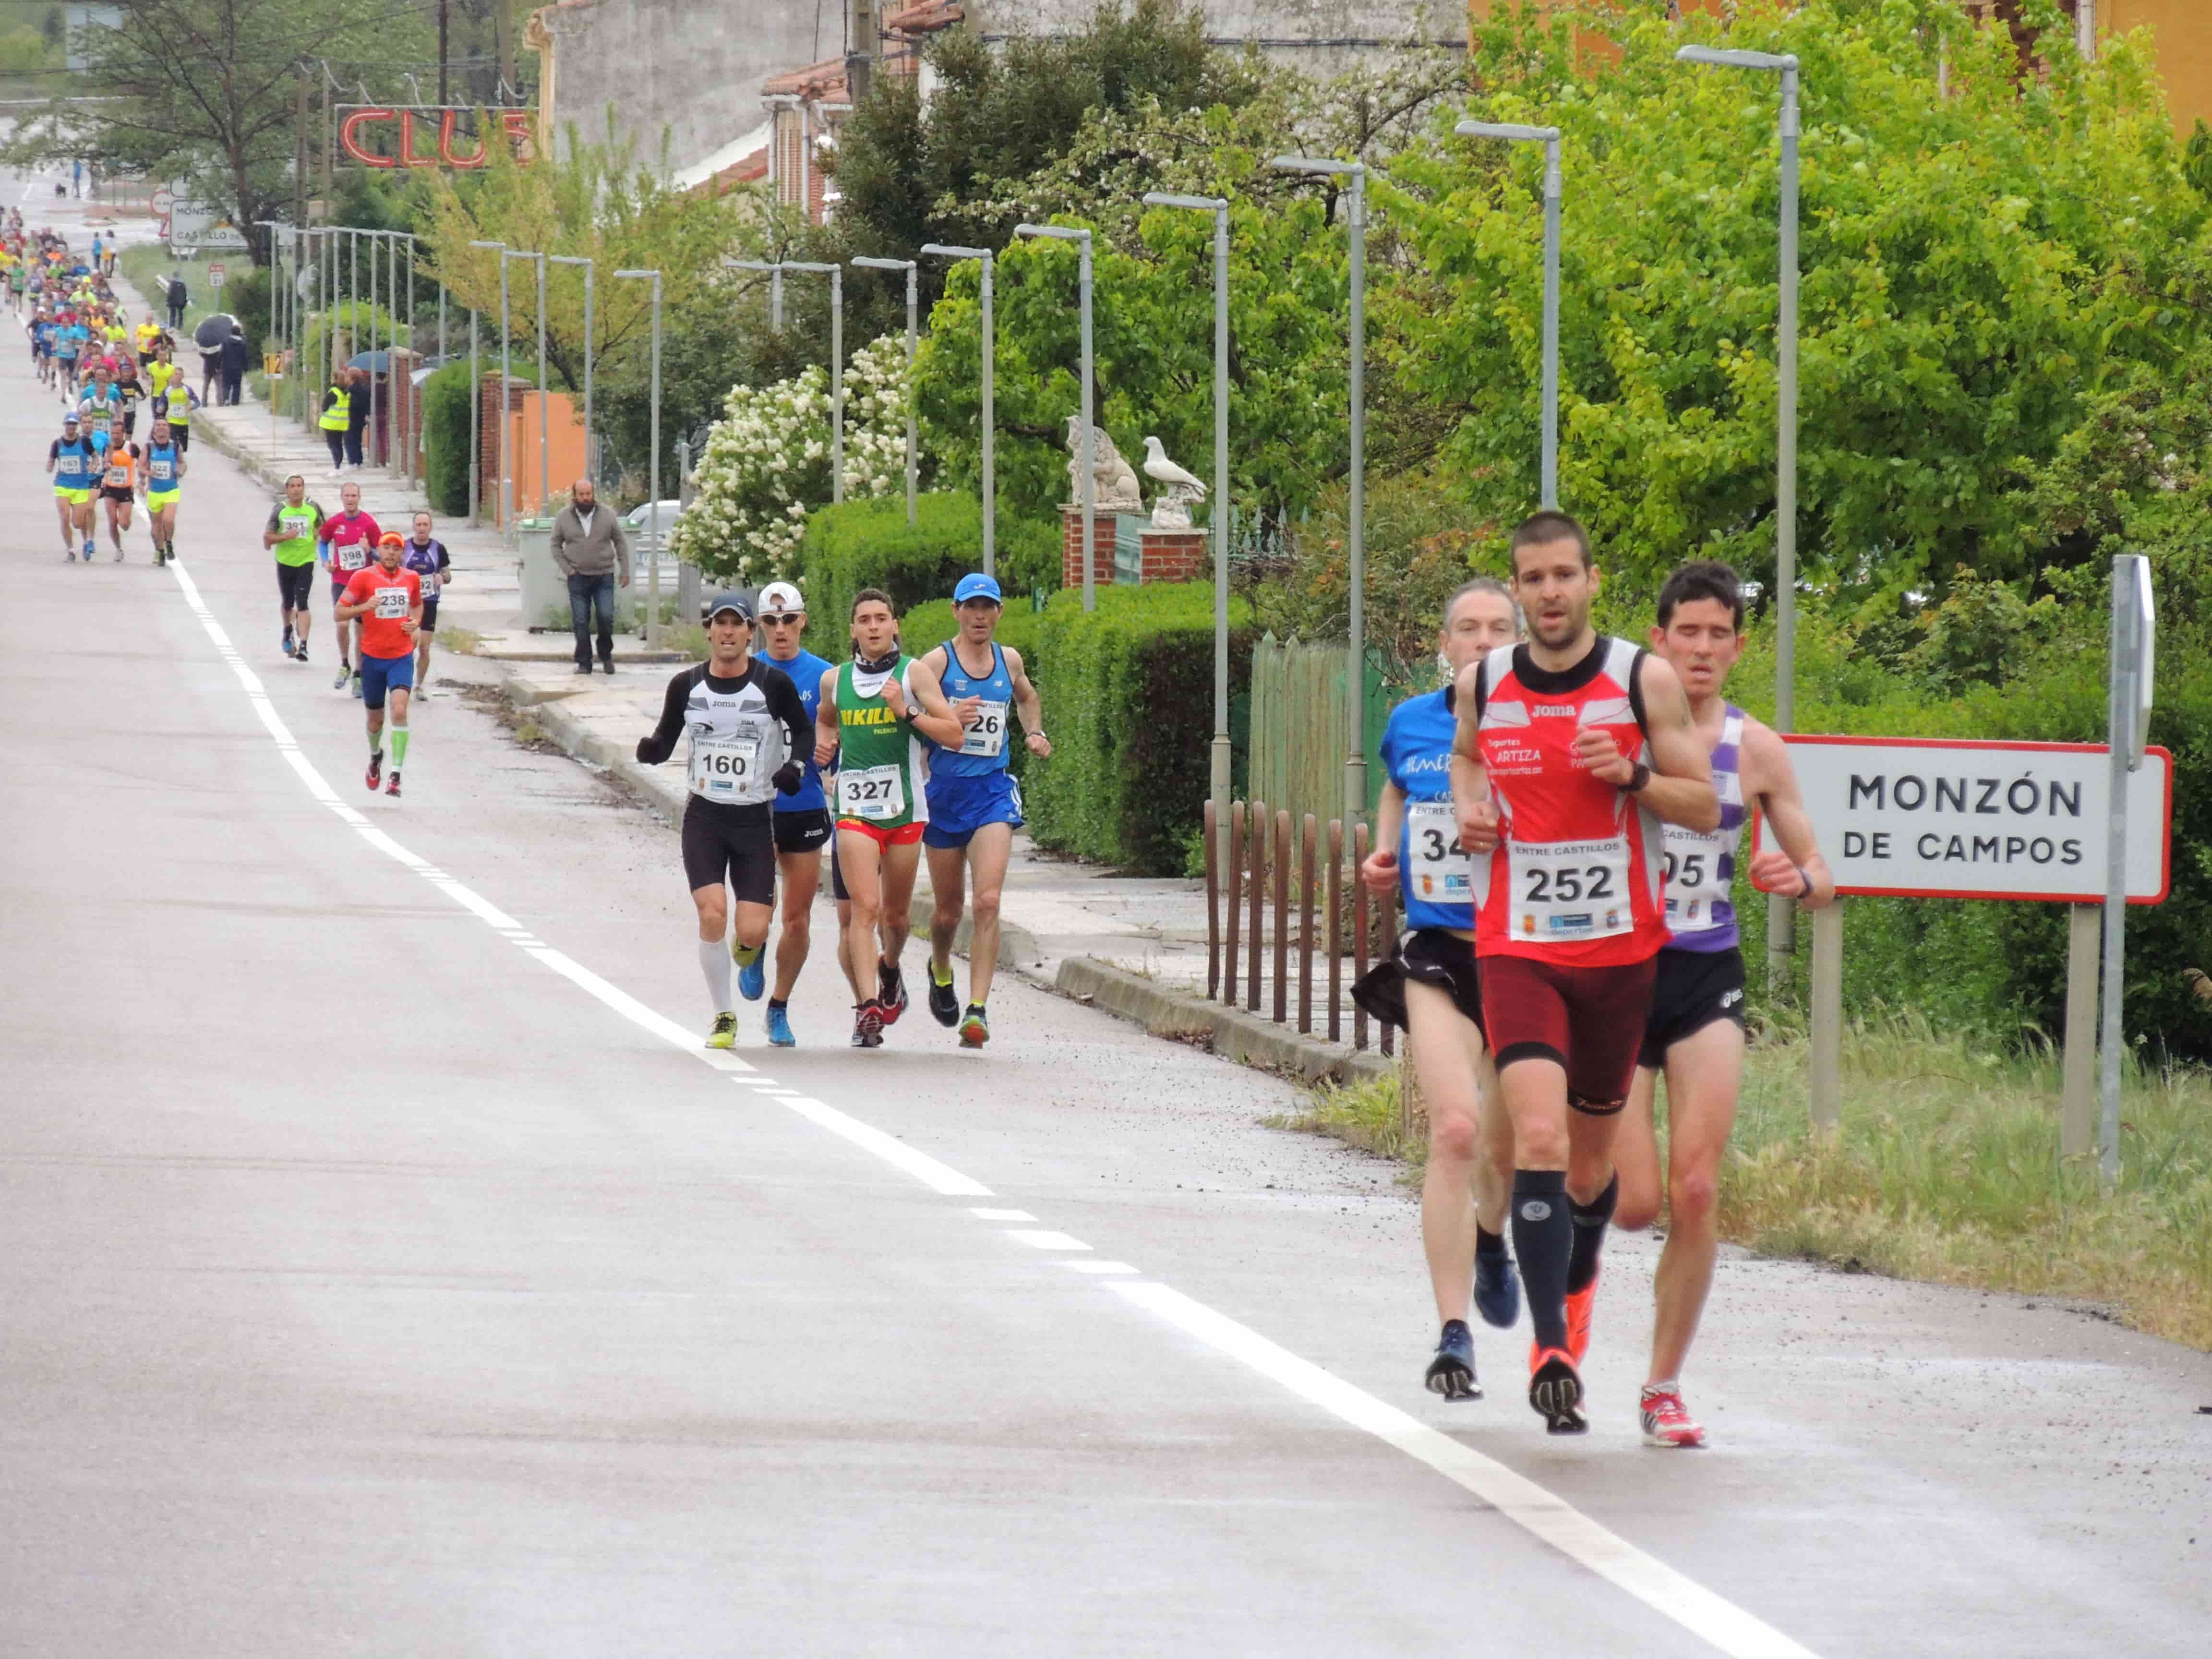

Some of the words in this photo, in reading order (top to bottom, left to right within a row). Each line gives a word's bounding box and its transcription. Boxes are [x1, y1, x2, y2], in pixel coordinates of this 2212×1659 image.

[176, 207, 206, 216] MONZ
[342, 550, 362, 562] 398
[381, 595, 406, 606] 238
[969, 715, 998, 734] 26
[703, 754, 746, 776] 160
[1406, 753, 1453, 772] HEMER
[1497, 749, 1541, 763] ARTIZA
[847, 779, 893, 801] 327
[1849, 771, 2082, 817] MONZÓN
[1416, 806, 1445, 815] ENTRE
[1423, 829, 1471, 862] 34
[1515, 846, 1551, 856] ENTRE
[1555, 842, 1620, 855] CASTILLOS
[1844, 831, 1892, 860] DE
[1917, 833, 2083, 865] CAMPOS
[1526, 866, 1614, 903] 252
